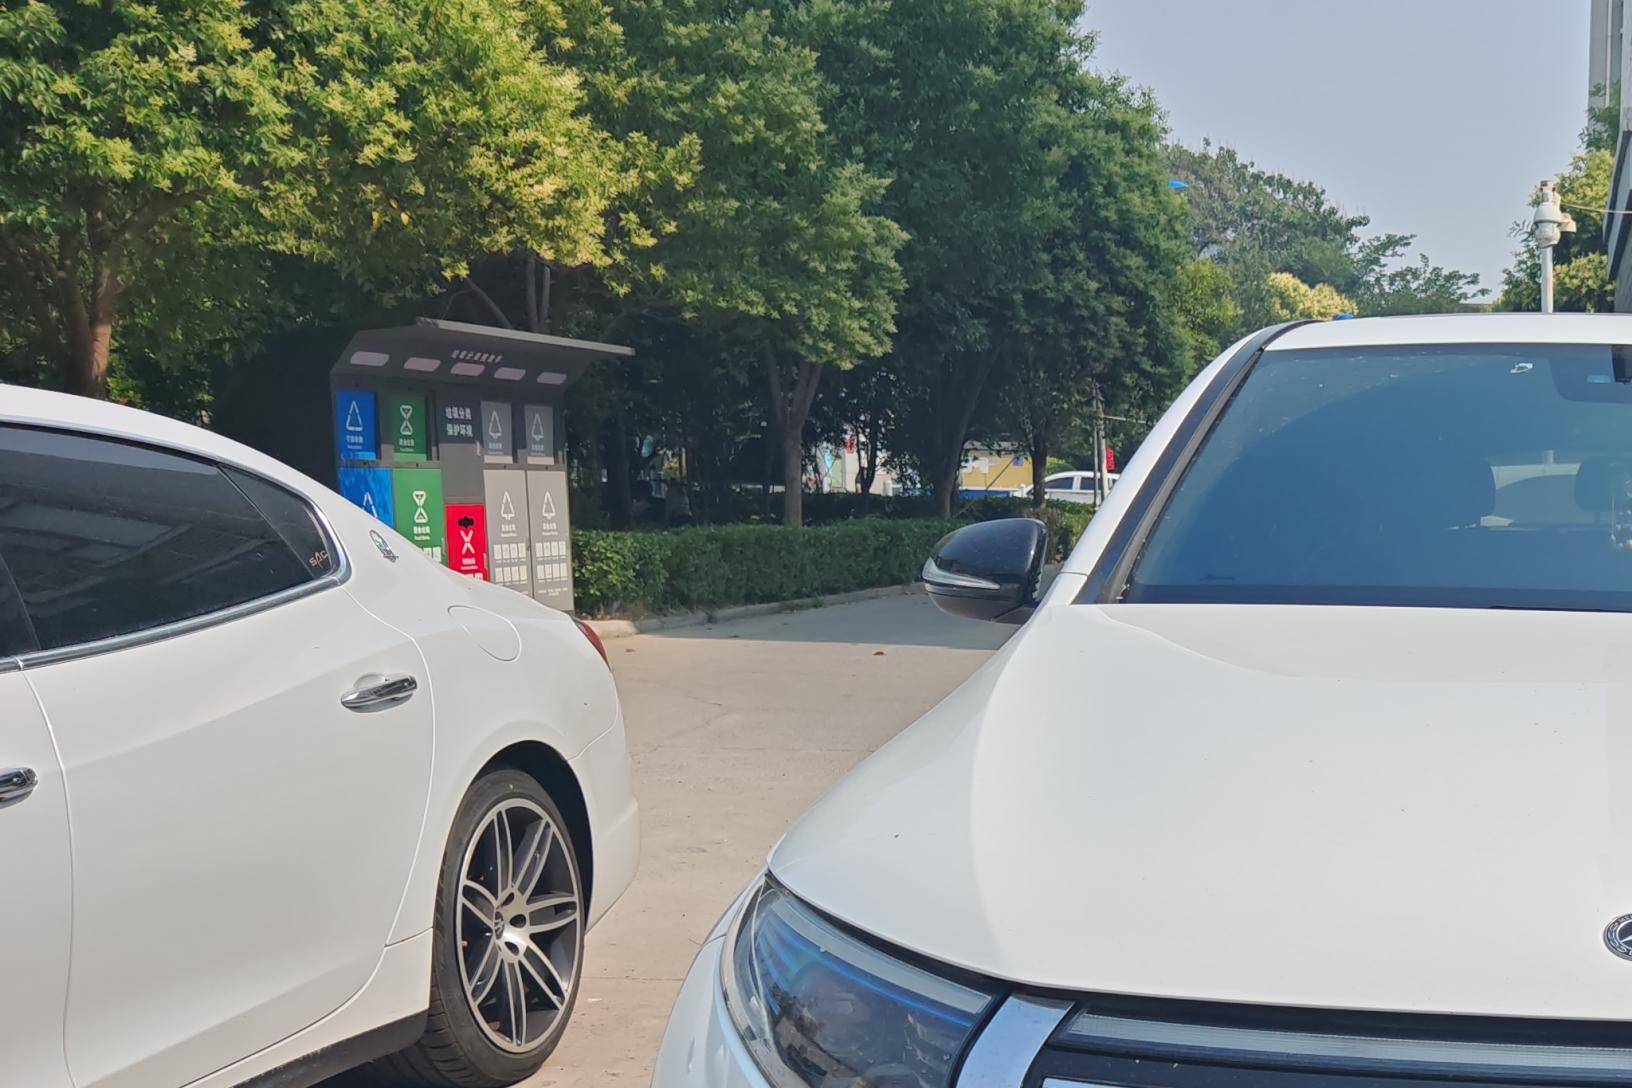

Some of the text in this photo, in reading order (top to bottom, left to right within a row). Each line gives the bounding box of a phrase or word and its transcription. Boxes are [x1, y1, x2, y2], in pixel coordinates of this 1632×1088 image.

[445, 406, 472, 420] 垃圾分类
[446, 423, 474, 437] 保护环境
